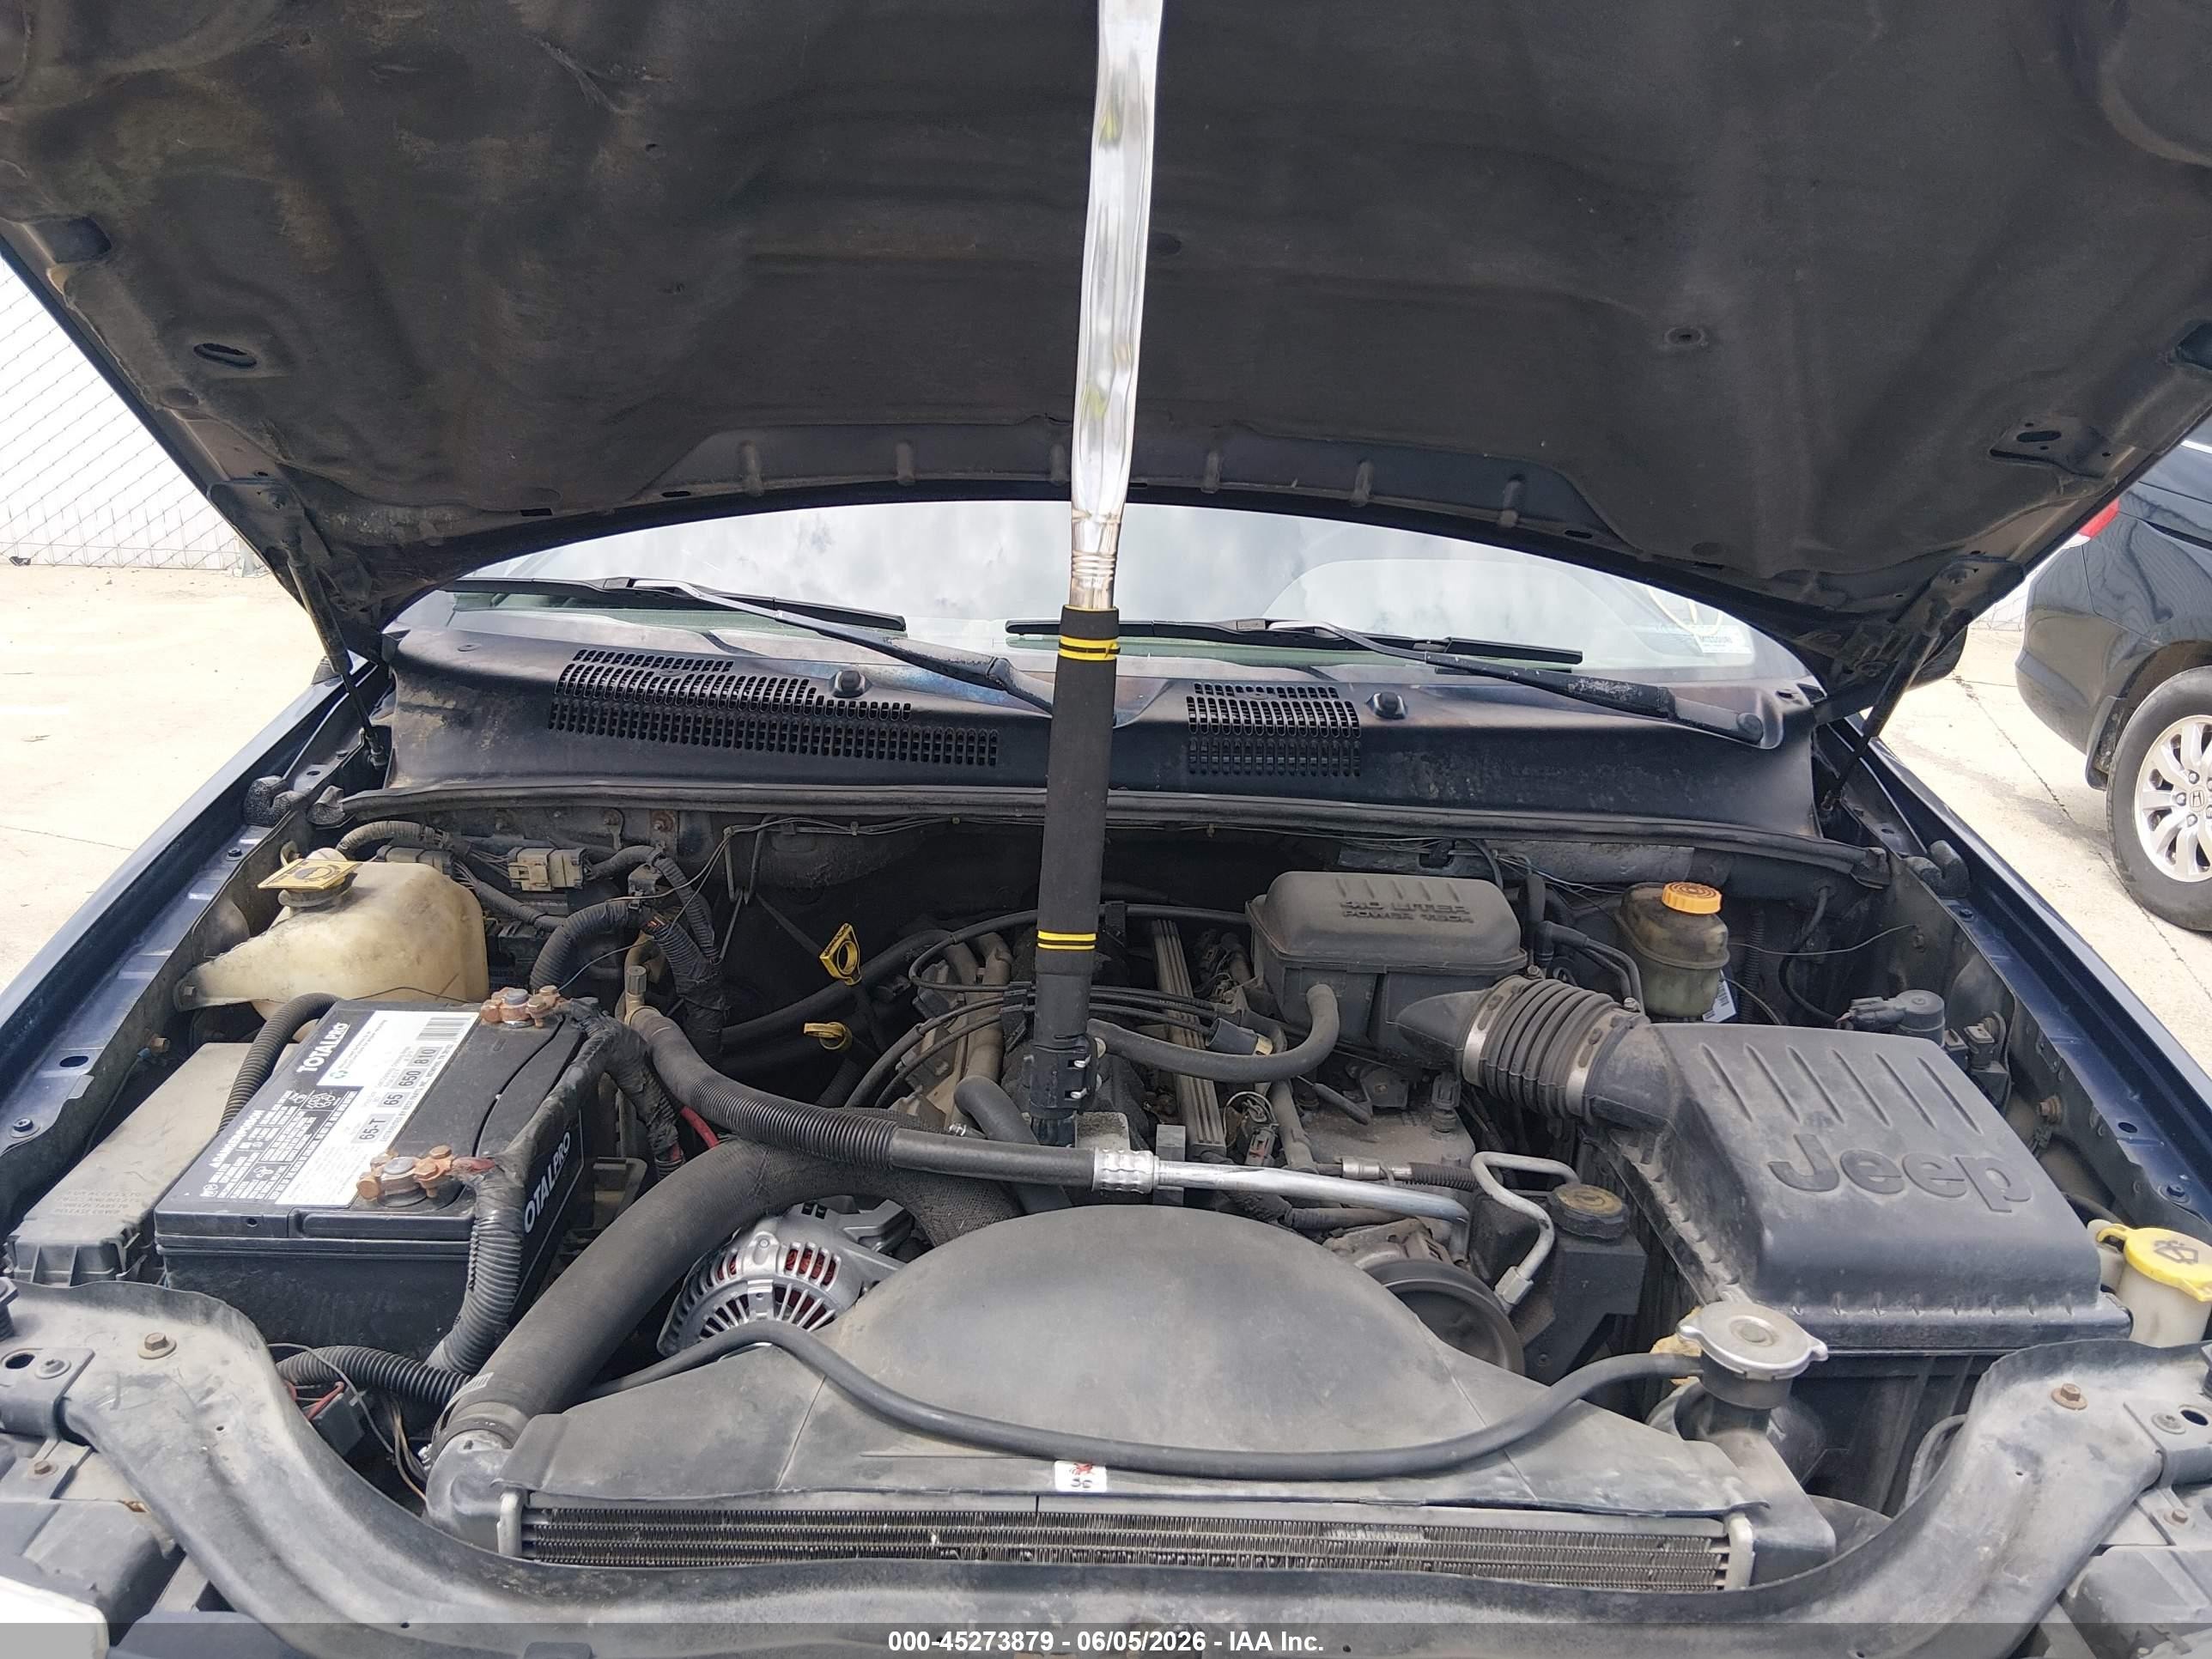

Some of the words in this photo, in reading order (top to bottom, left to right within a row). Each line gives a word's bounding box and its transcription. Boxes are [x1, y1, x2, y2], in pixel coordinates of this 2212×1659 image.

[1342, 911, 1414, 921] POWER
[1391, 902, 1470, 915] LITER
[295, 1022, 350, 1073] TOTALPRO
[415, 1048, 436, 1065] 810
[398, 1070, 422, 1087] 650
[384, 1094, 404, 1106] 65
[359, 1118, 386, 1140] 65-T
[1767, 1133, 2033, 1213] Jeep
[524, 1131, 571, 1234] OTALPRO
